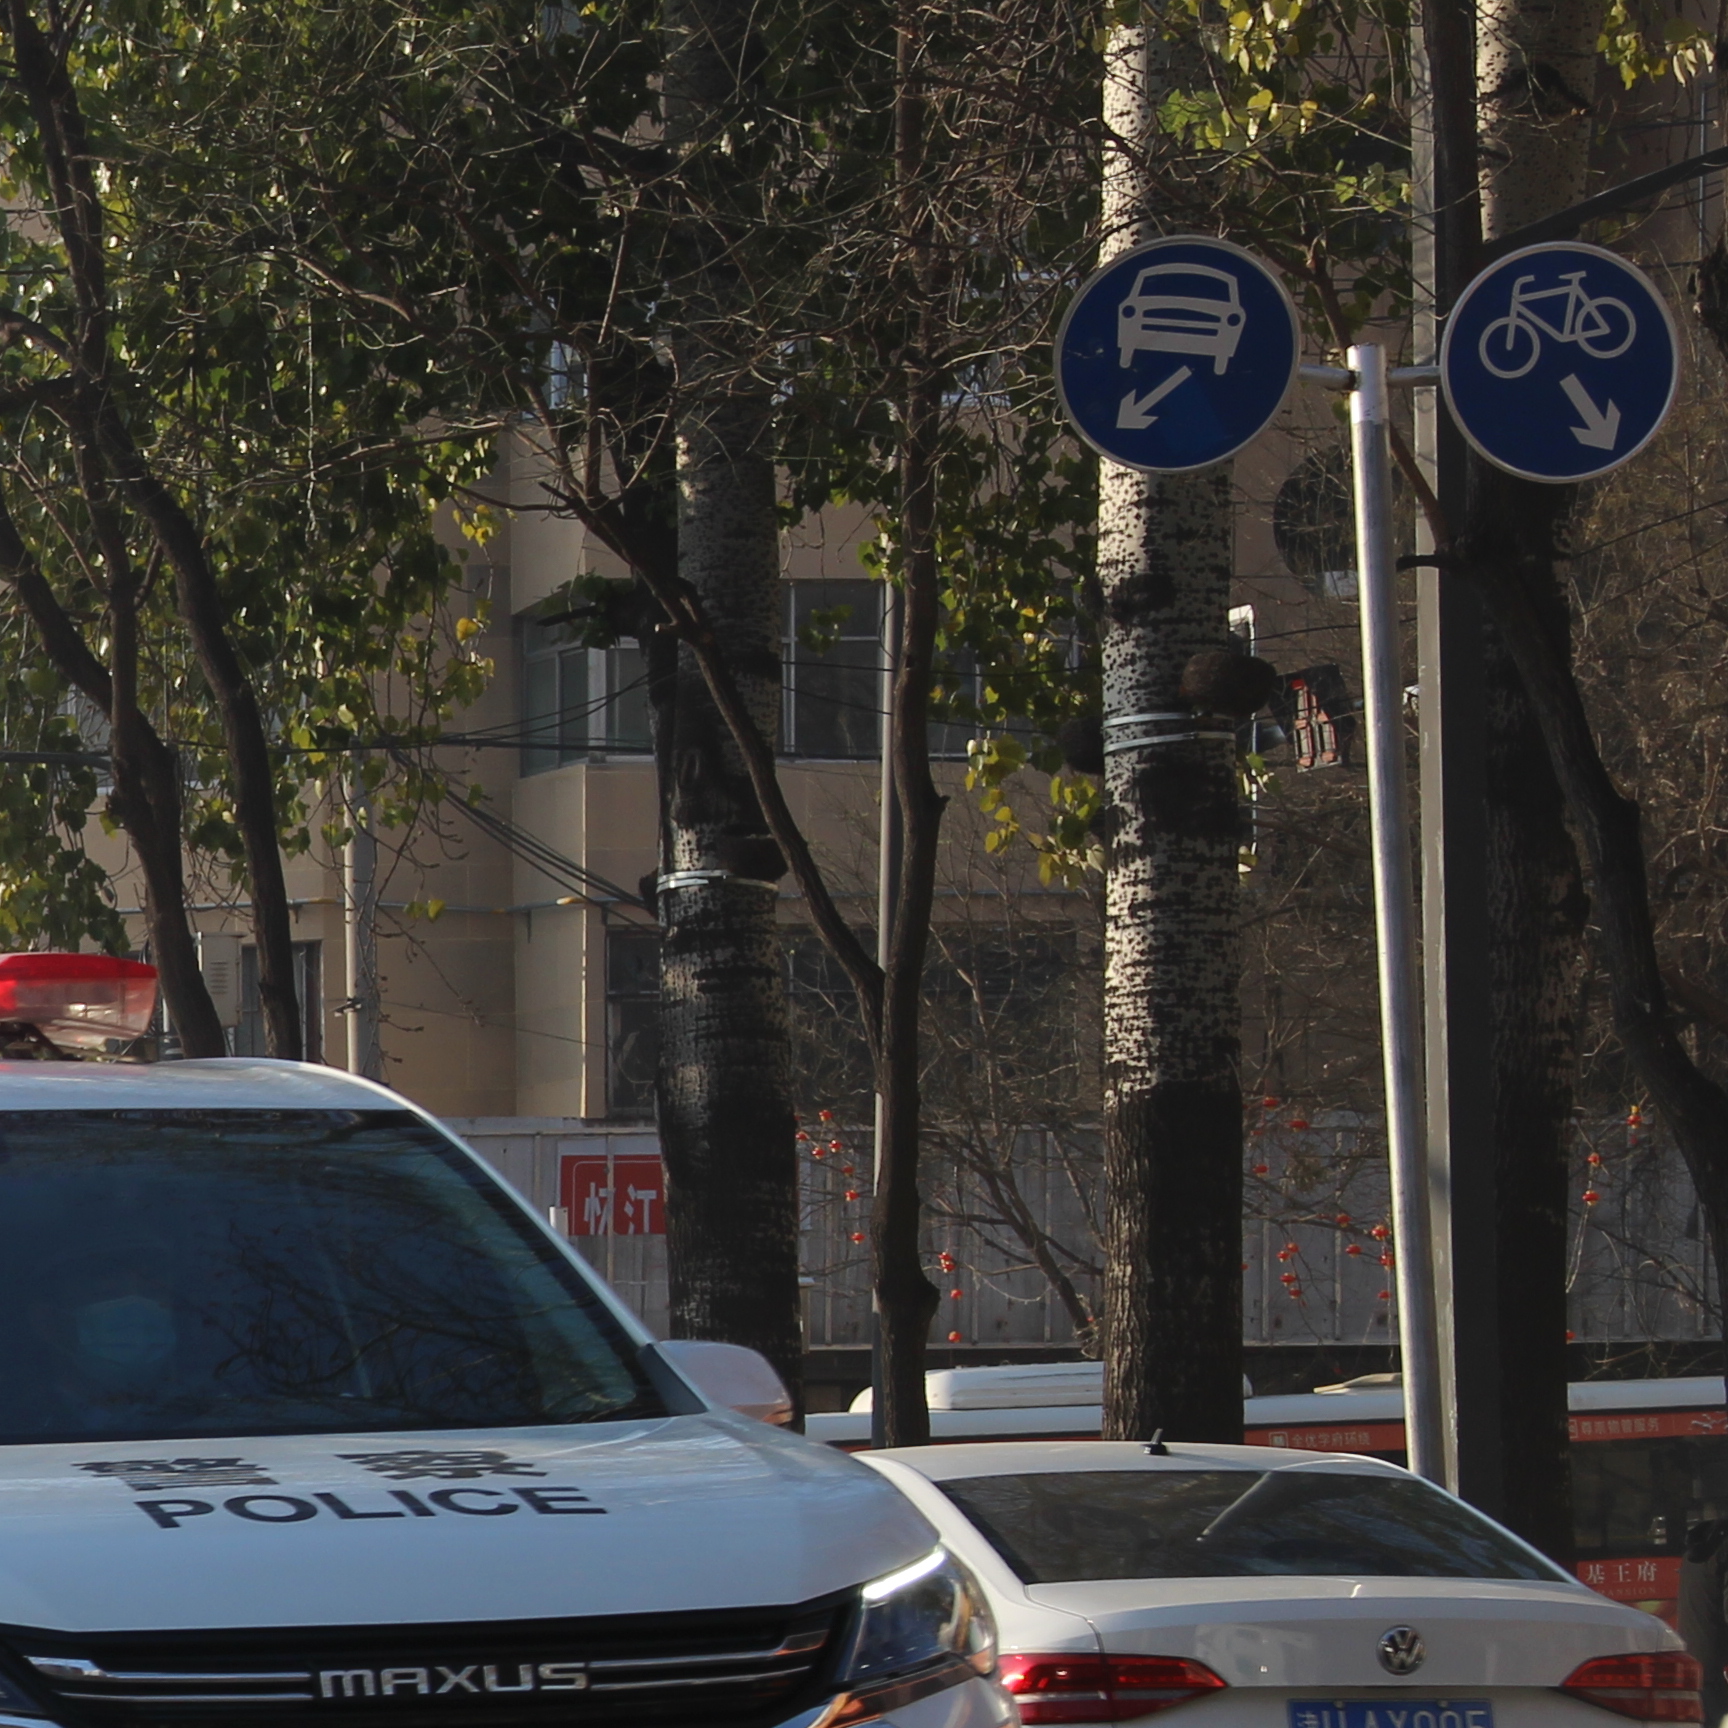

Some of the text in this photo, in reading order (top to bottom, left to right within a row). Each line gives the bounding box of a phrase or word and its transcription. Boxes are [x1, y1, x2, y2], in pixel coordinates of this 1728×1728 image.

[70, 1450, 548, 1492] 警察
[134, 1486, 608, 1528] POLICE
[319, 1661, 588, 1699] MAXUS
